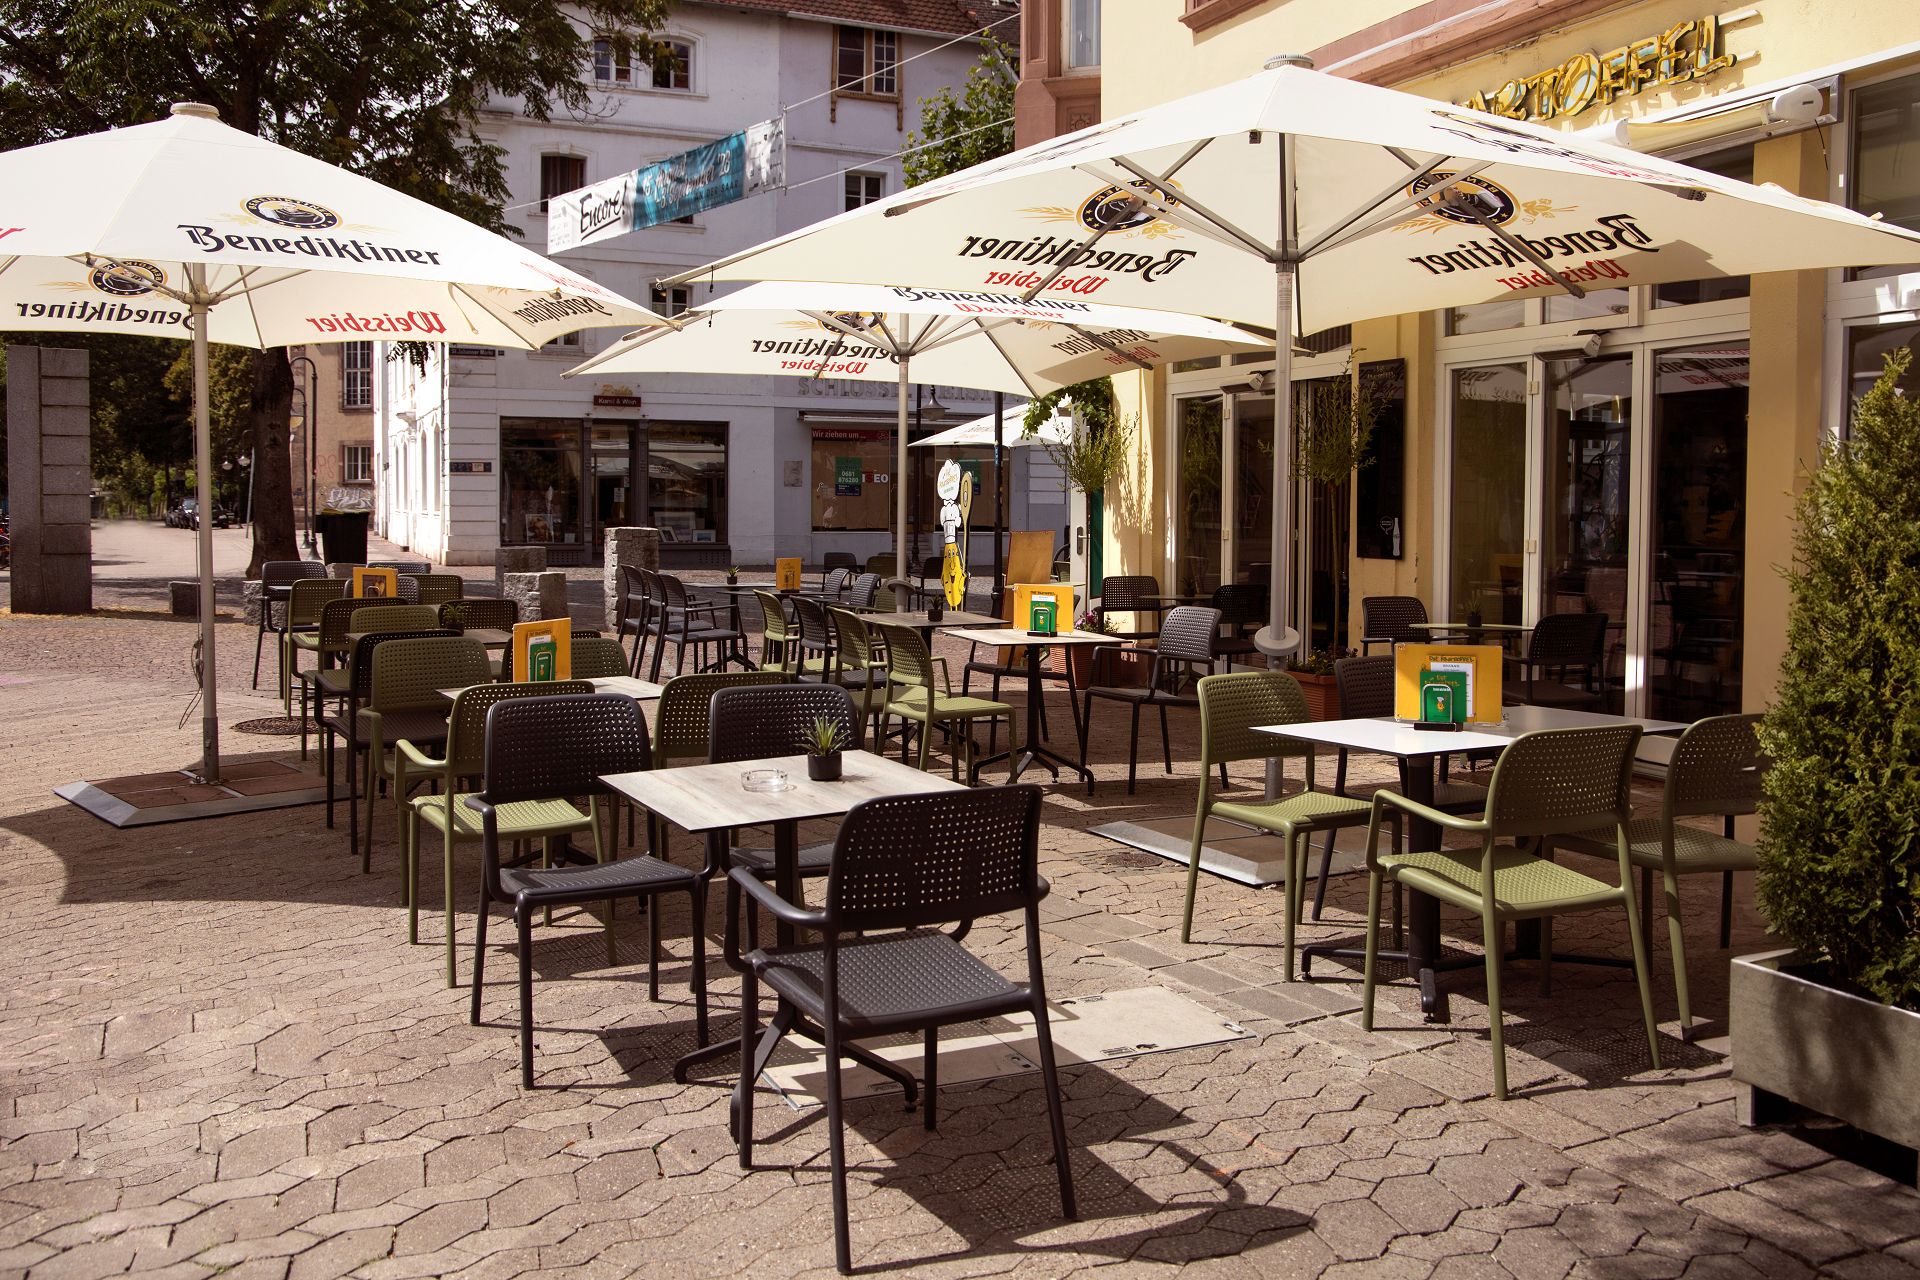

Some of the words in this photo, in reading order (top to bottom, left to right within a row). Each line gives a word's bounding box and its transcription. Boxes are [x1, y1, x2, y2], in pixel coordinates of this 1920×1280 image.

[580, 180, 628, 234] Encore!
[177, 224, 441, 266] Benediktiner
[825, 430, 848, 439] ziehen
